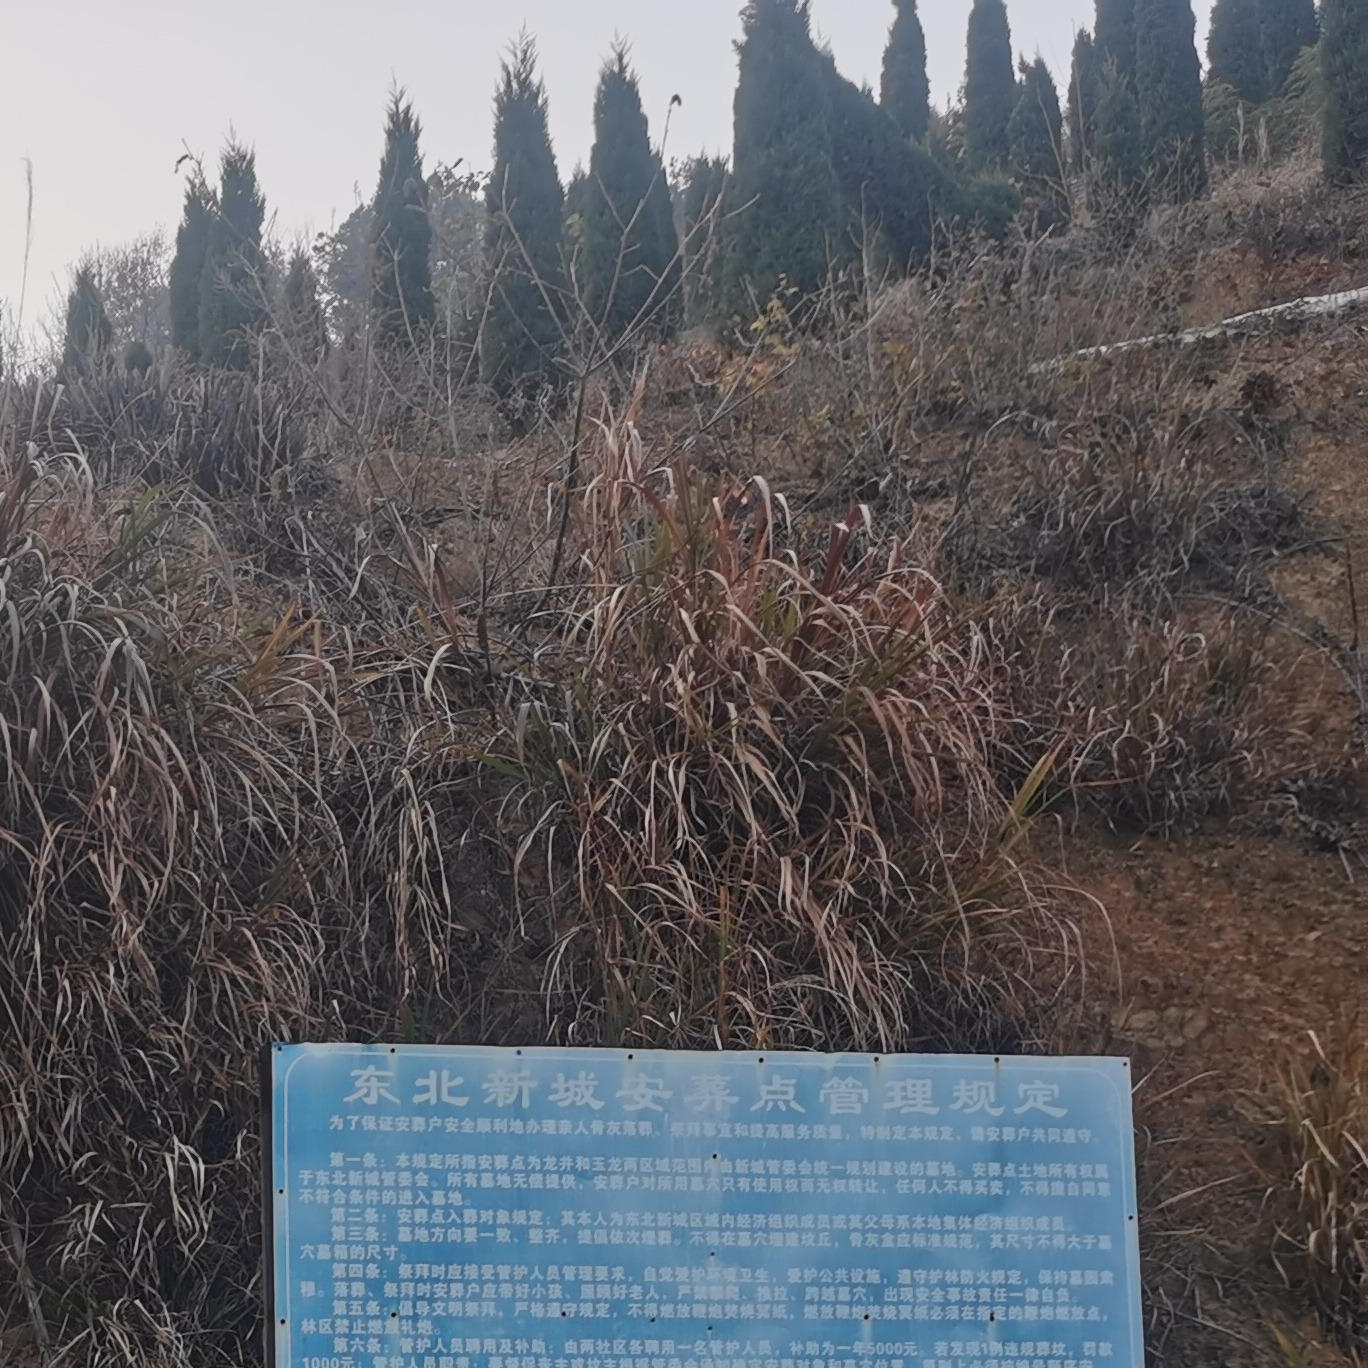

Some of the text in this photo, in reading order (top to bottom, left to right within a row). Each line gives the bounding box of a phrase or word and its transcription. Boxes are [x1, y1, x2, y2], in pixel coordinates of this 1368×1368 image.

[343, 1065, 1068, 1118] 东北新城安葬点管理规定
